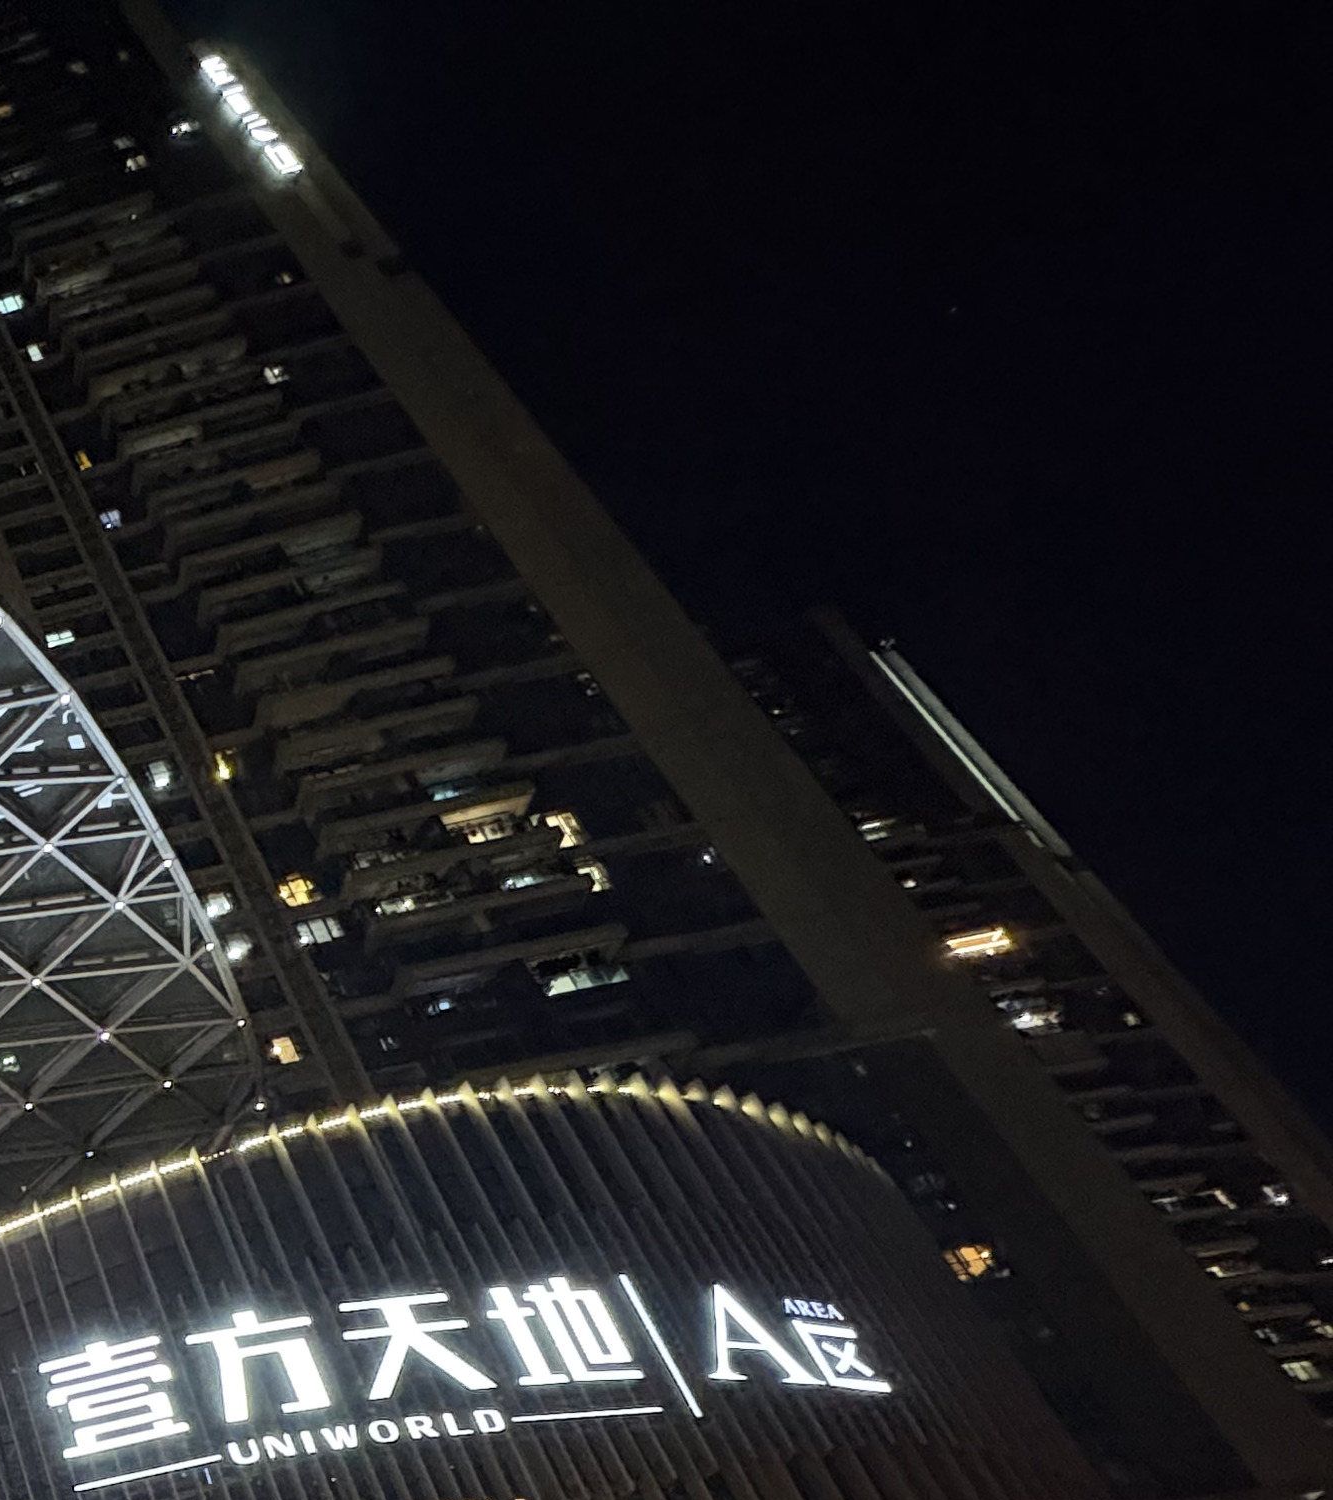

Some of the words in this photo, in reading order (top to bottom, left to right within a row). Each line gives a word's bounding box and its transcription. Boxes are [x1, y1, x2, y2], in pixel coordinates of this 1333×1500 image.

[782, 1296, 846, 1322] AREA
[38, 1275, 646, 1460] 壹方天地
[226, 1406, 509, 1467] UNIWORLD
